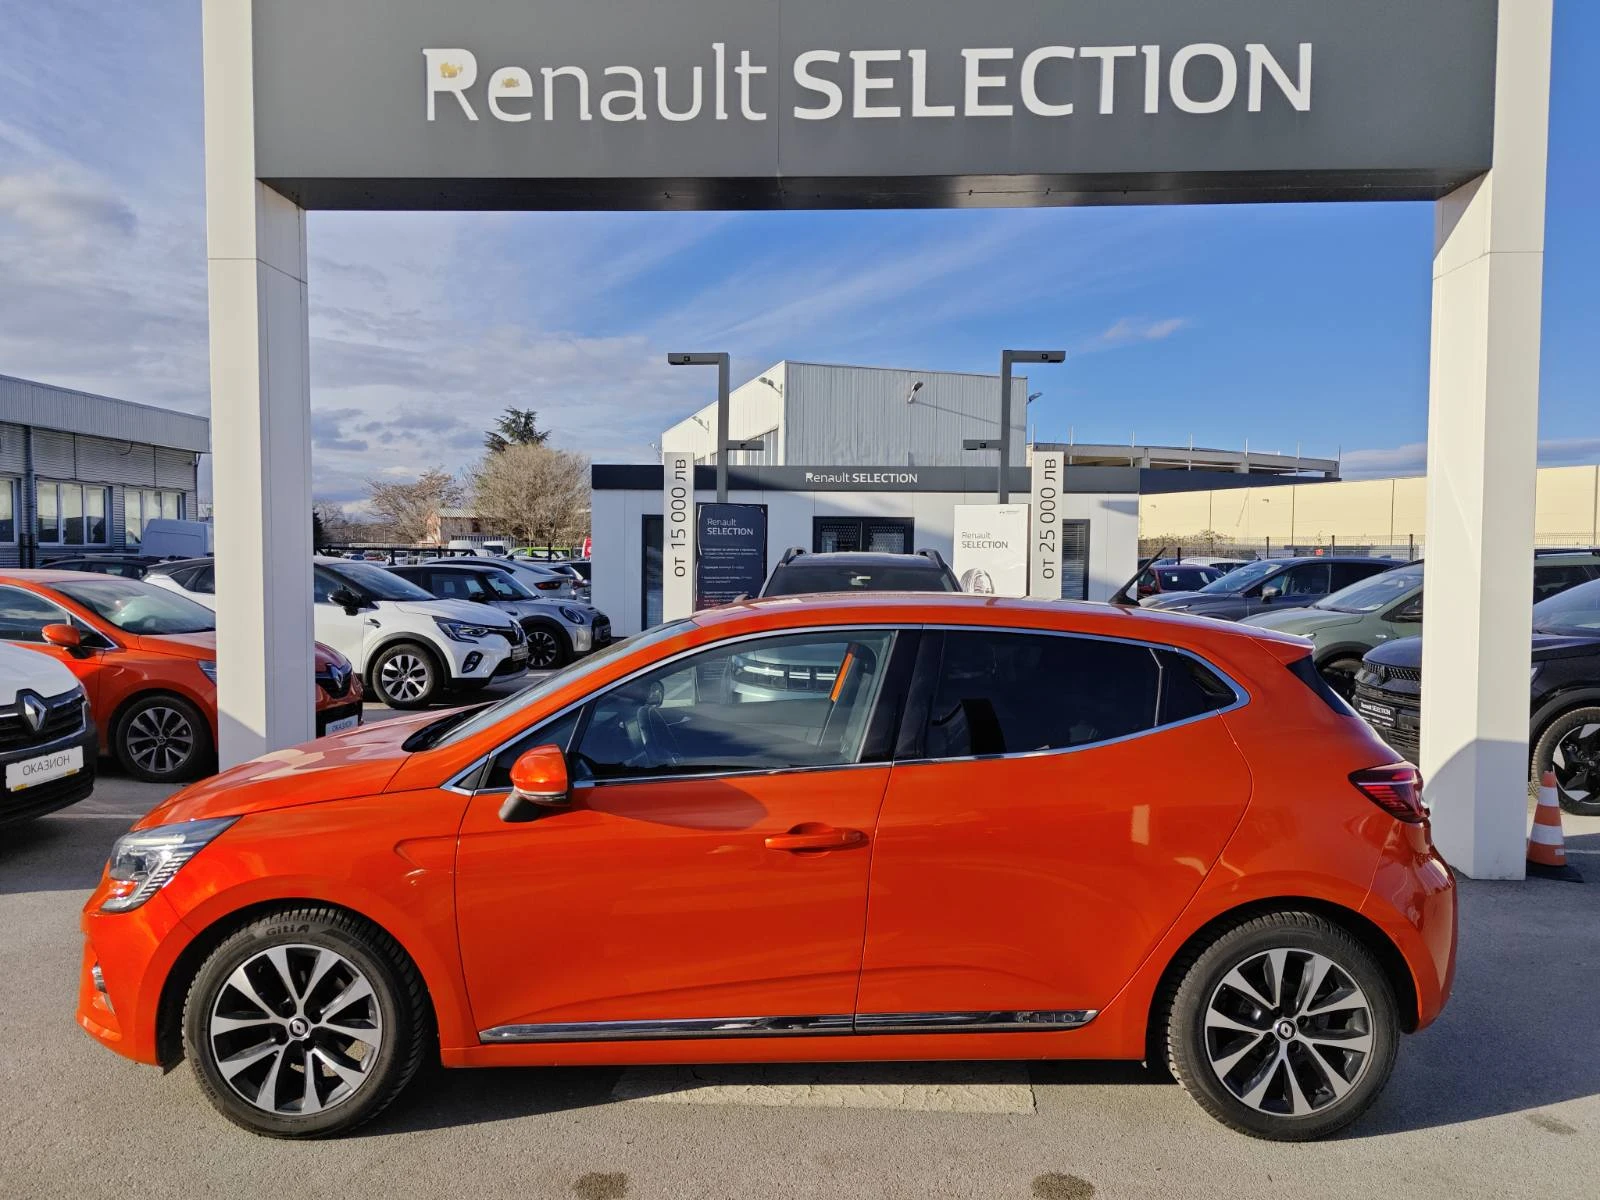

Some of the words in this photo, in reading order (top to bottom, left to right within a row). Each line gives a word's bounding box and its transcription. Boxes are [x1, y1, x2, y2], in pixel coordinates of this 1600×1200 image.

[422, 42, 767, 122] Renault
[793, 42, 1312, 120] SELECTION
[805, 472, 850, 483] Renault
[852, 473, 918, 483] SELECTION
[671, 487, 686, 523] 000
[1039, 487, 1056, 524] 000
[707, 518, 737, 526] Renault
[707, 527, 754, 536] SELECTION
[671, 528, 687, 550] 15
[961, 531, 991, 539] Renault
[961, 540, 1009, 549] SELECTION
[1039, 530, 1056, 552] 25
[22, 754, 71, 776] ОКАЗИОН
